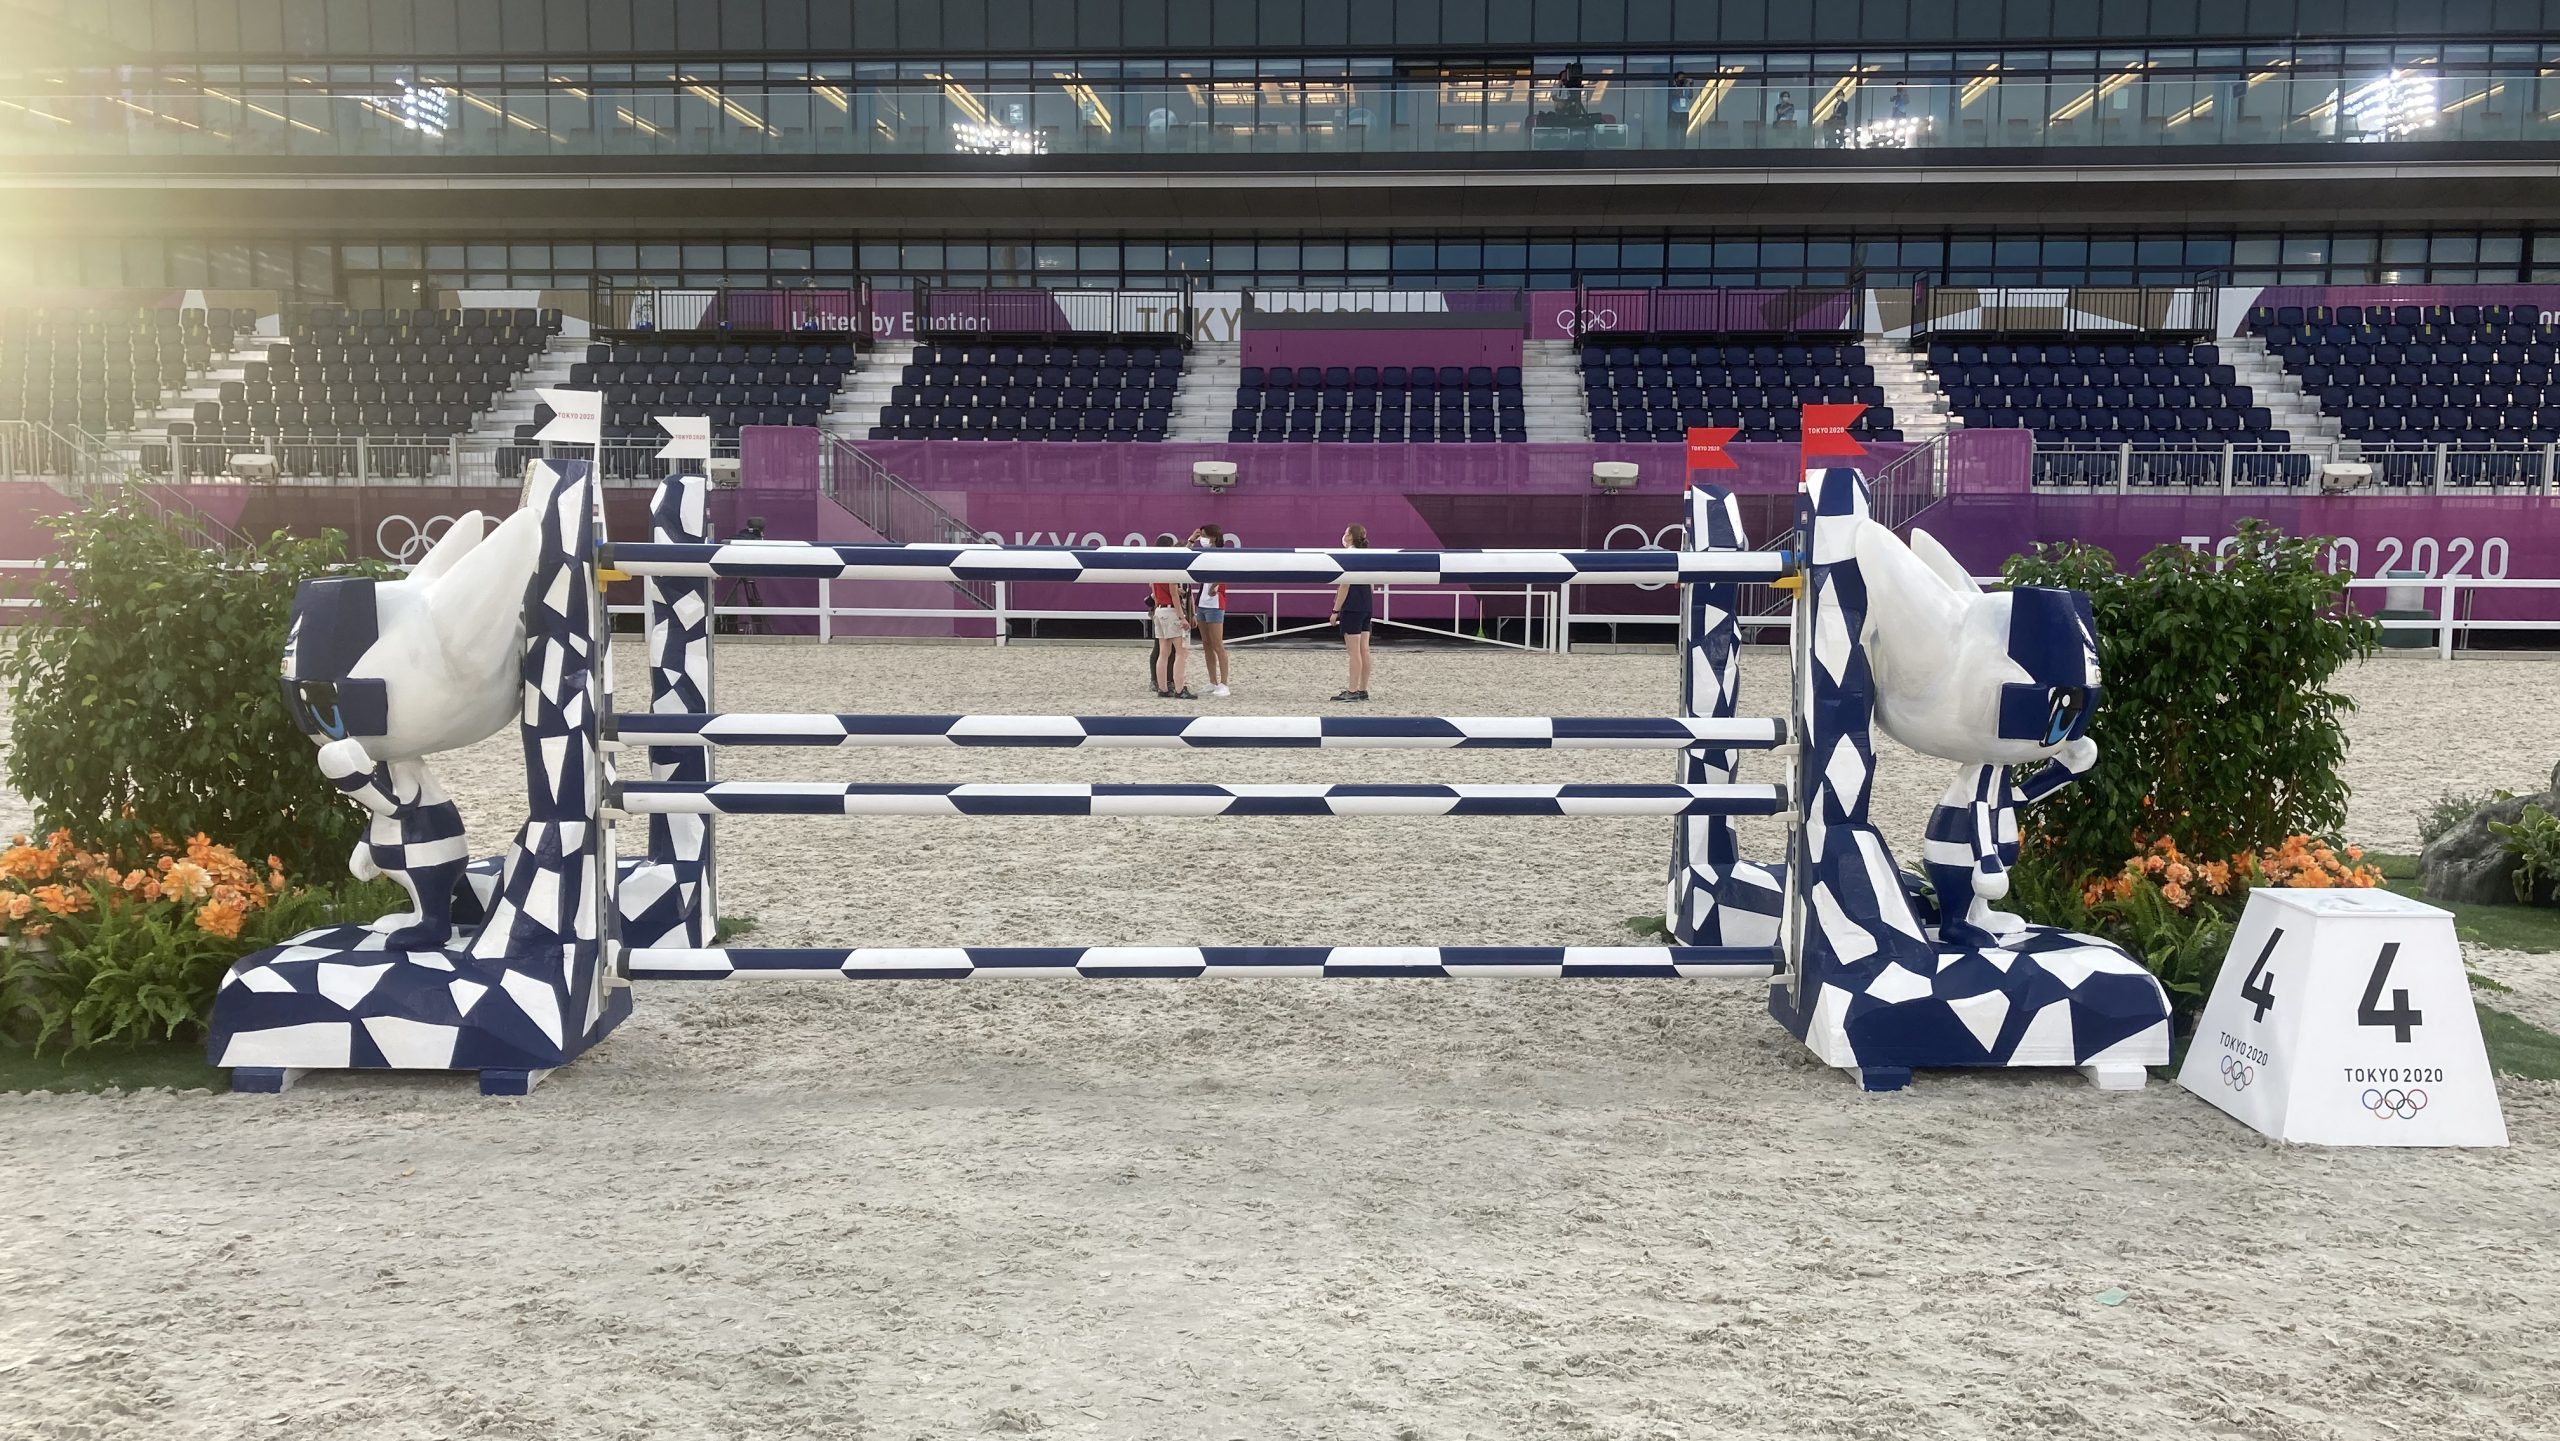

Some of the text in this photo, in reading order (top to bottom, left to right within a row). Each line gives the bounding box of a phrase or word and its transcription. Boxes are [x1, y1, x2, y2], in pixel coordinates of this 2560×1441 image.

[872, 312, 895, 336] by
[1136, 307, 1265, 342] TOKY
[1829, 426, 1845, 434] 2020
[2375, 536, 2509, 580] 2020
[2240, 927, 2284, 1023] 4
[2357, 942, 2423, 1043] 4
[2220, 1031, 2268, 1066] TOKYO 2020
[2344, 1068, 2443, 1082] TOKYO 2020
